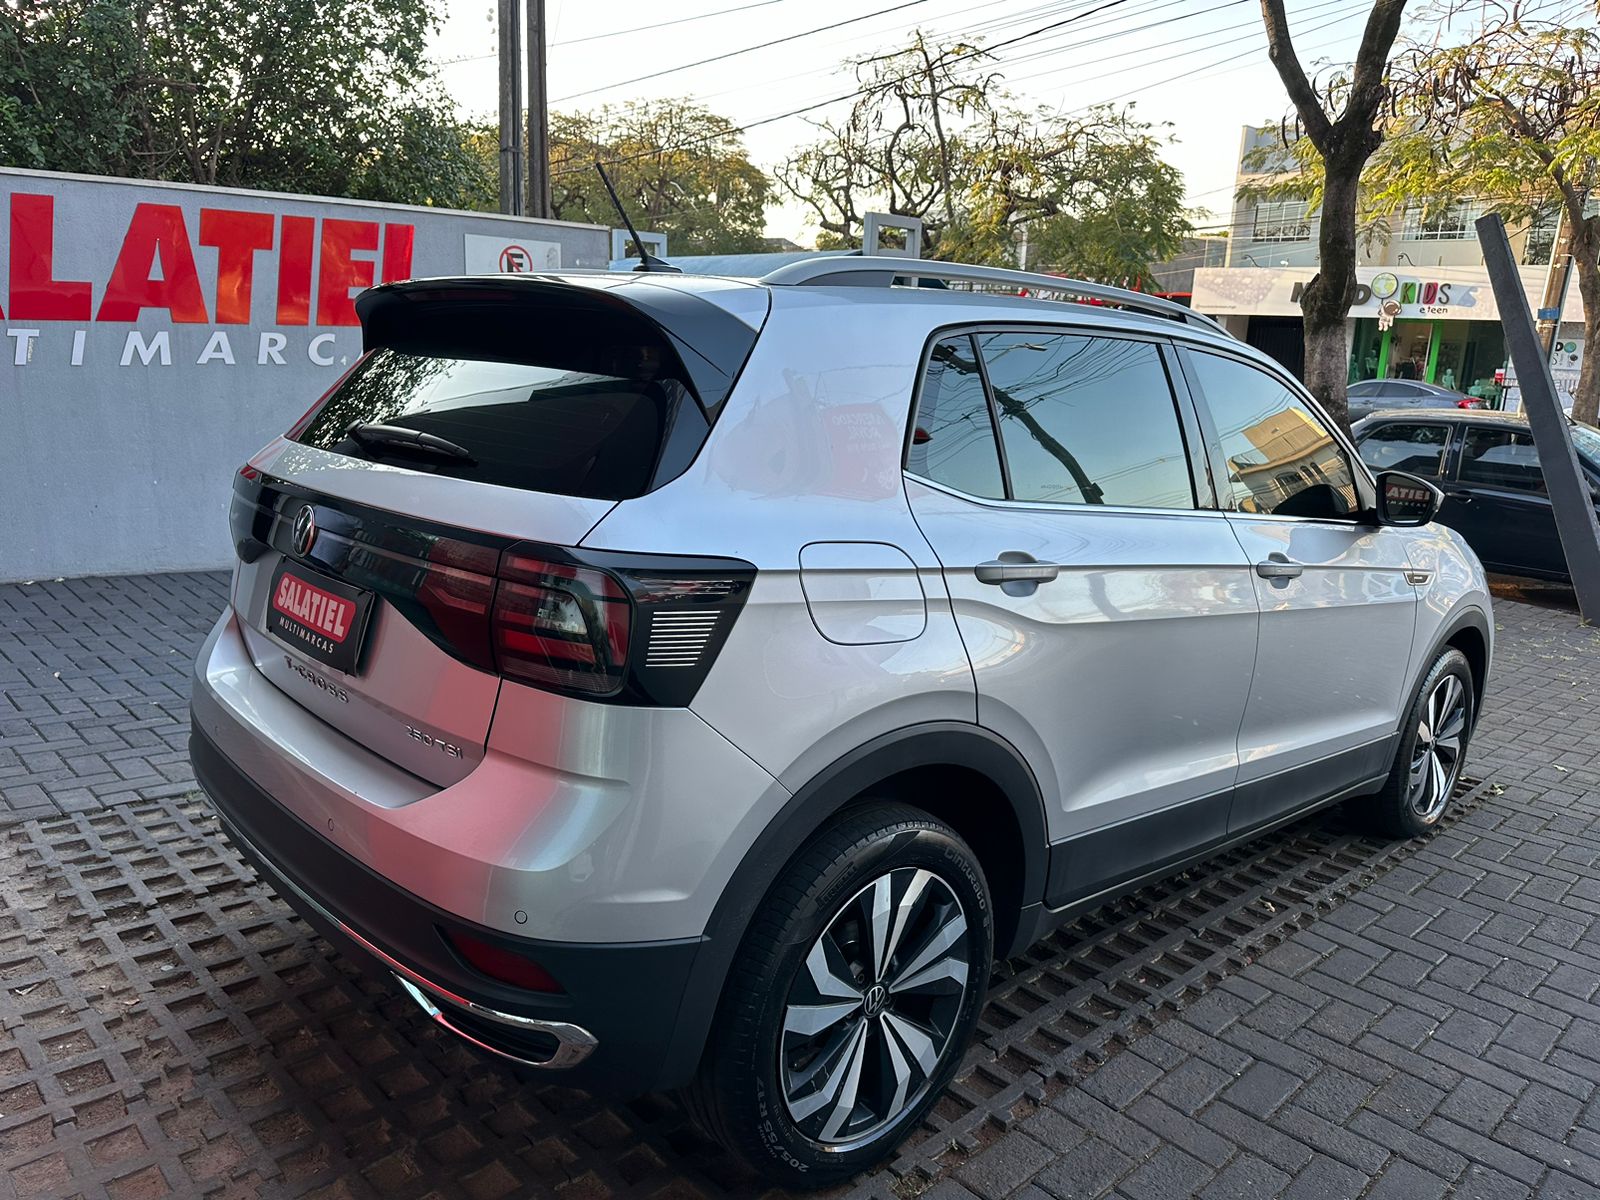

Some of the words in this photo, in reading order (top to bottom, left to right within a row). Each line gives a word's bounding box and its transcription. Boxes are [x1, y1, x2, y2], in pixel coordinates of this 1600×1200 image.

[1402, 282, 1452, 304] KIDS
[1427, 306, 1448, 314] teen
[278, 577, 346, 637] SALATIEL
[279, 616, 334, 654] MULTIMARCAS
[284, 655, 349, 703] T-CROSS
